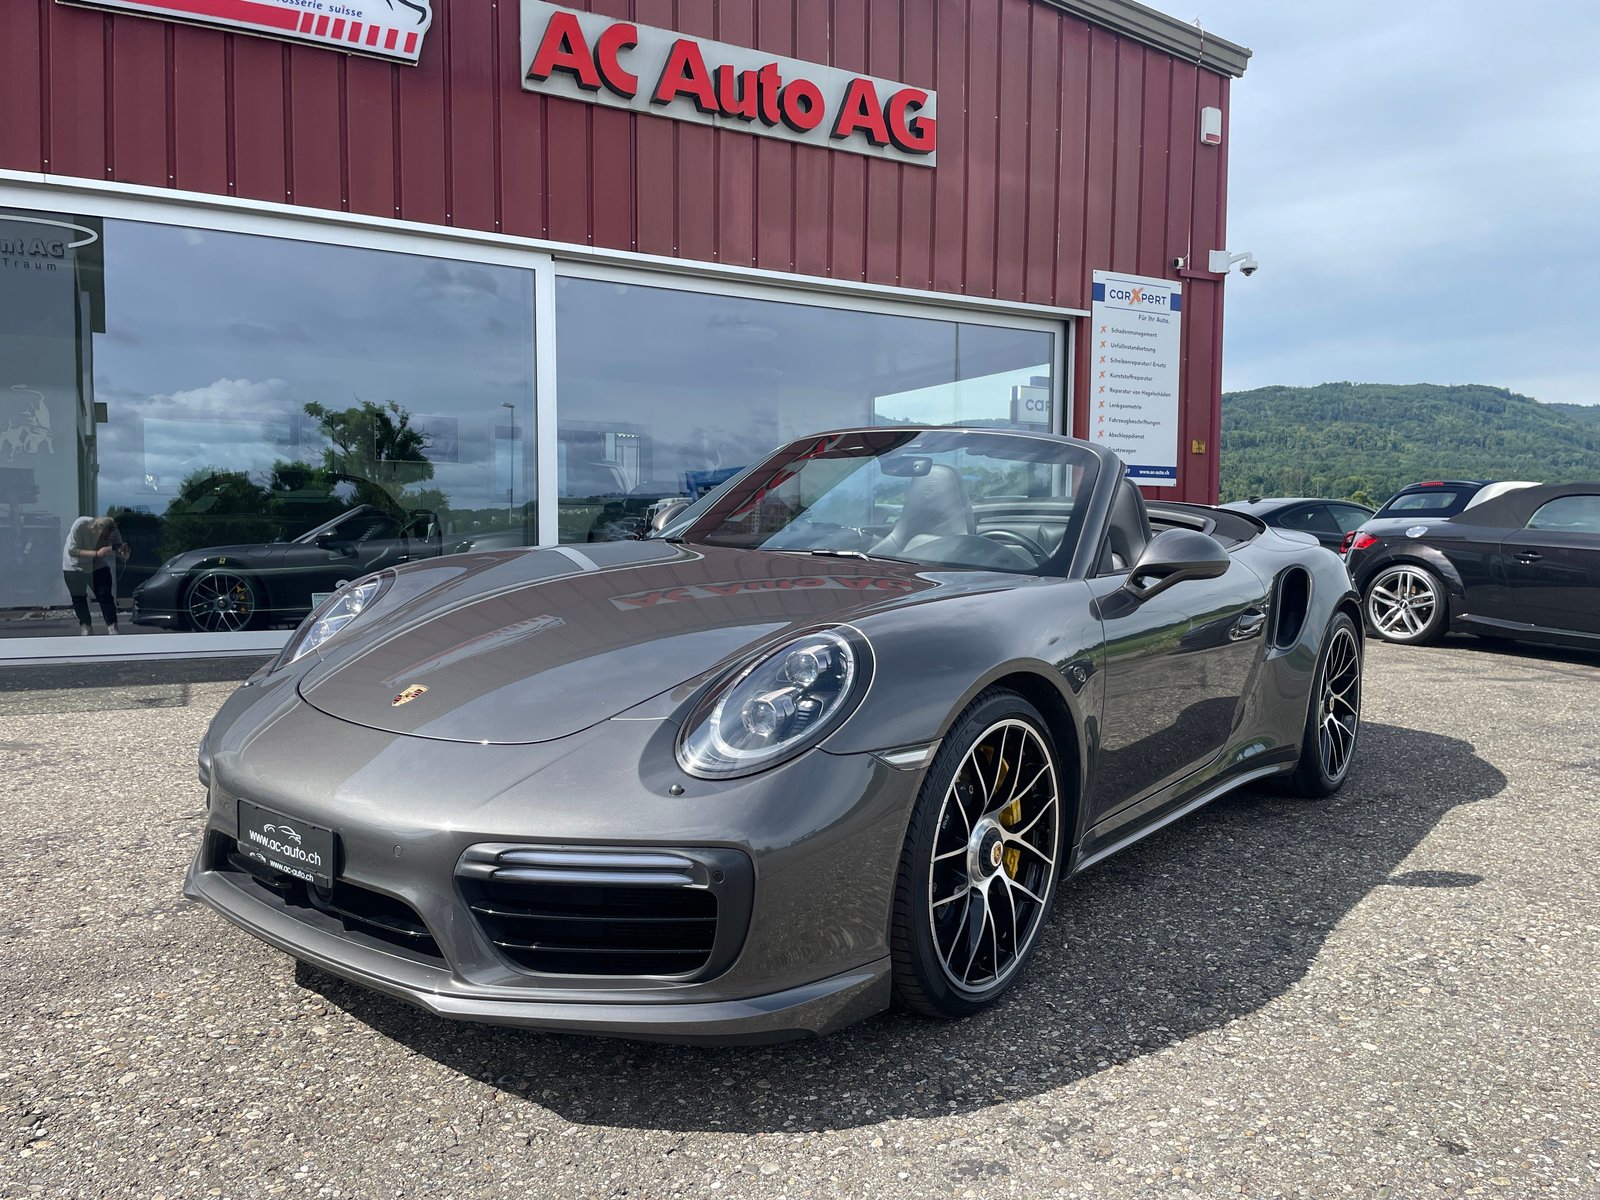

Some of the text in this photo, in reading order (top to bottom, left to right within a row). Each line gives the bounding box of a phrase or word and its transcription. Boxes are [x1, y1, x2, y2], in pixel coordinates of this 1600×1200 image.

[329, 5, 363, 17] suisse
[527, 11, 936, 155] AC Auto AG
[28, 238, 65, 258] AG
[1111, 328, 1157, 337] Schadenmanagement
[1111, 343, 1156, 353] Unfallinstandsetzung
[1110, 373, 1152, 381] Kunststoffreparatur
[249, 829, 321, 867] www.ac-auto.ch
[269, 860, 314, 882] www.ac-auto.ch
